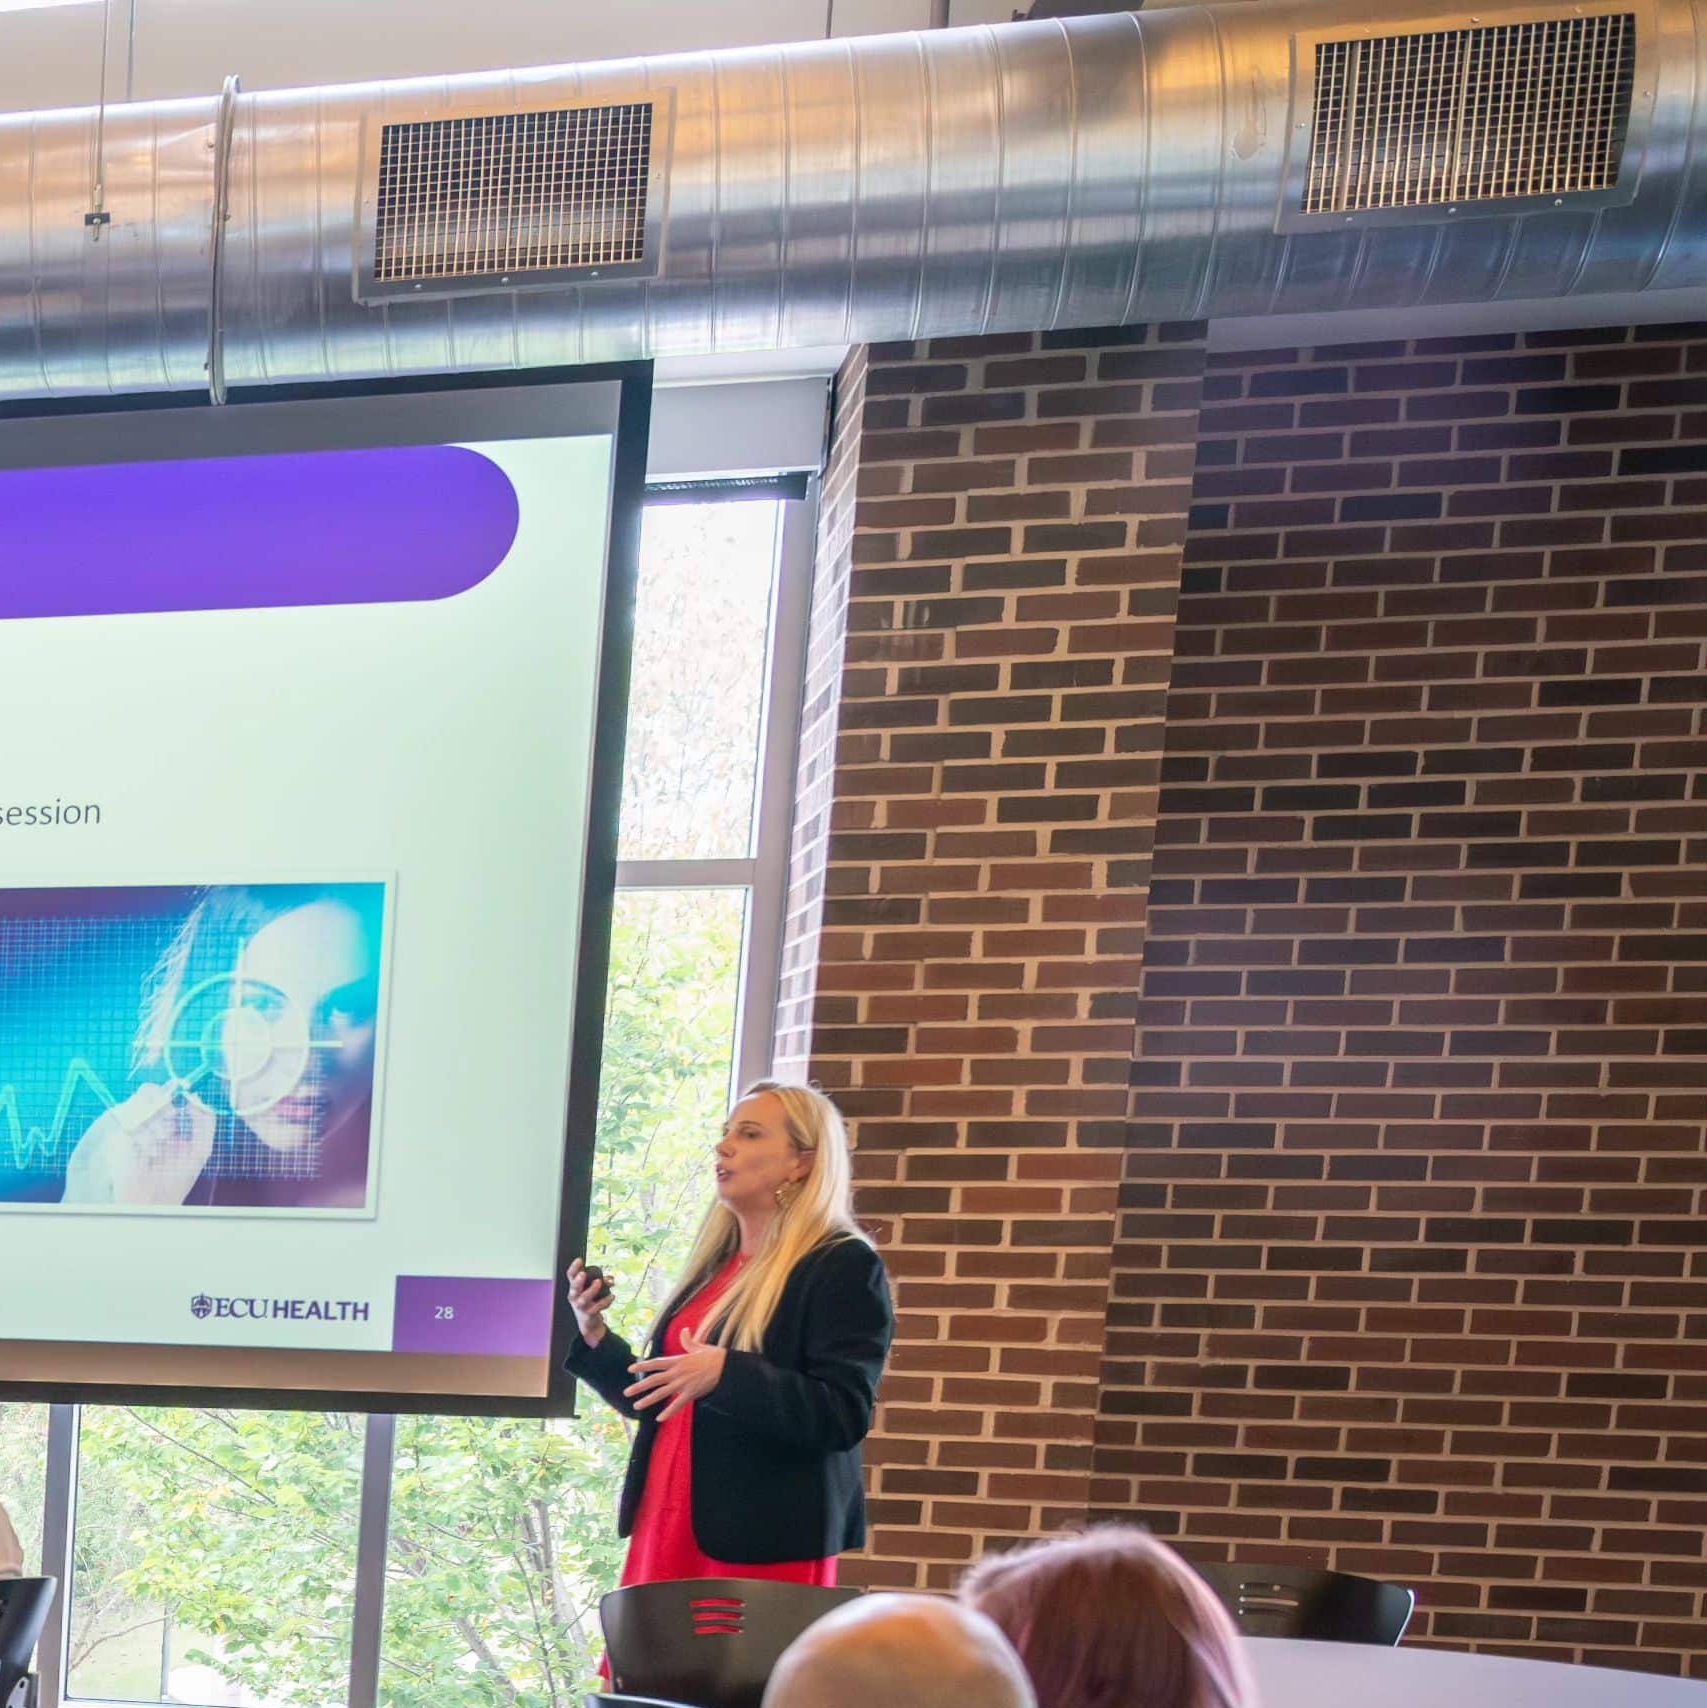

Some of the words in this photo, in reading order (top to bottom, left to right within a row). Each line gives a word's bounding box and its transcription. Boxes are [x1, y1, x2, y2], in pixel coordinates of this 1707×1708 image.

[214, 1297, 268, 1319] ECU
[272, 1299, 369, 1321] HEALTH
[434, 1305, 454, 1320] 28
